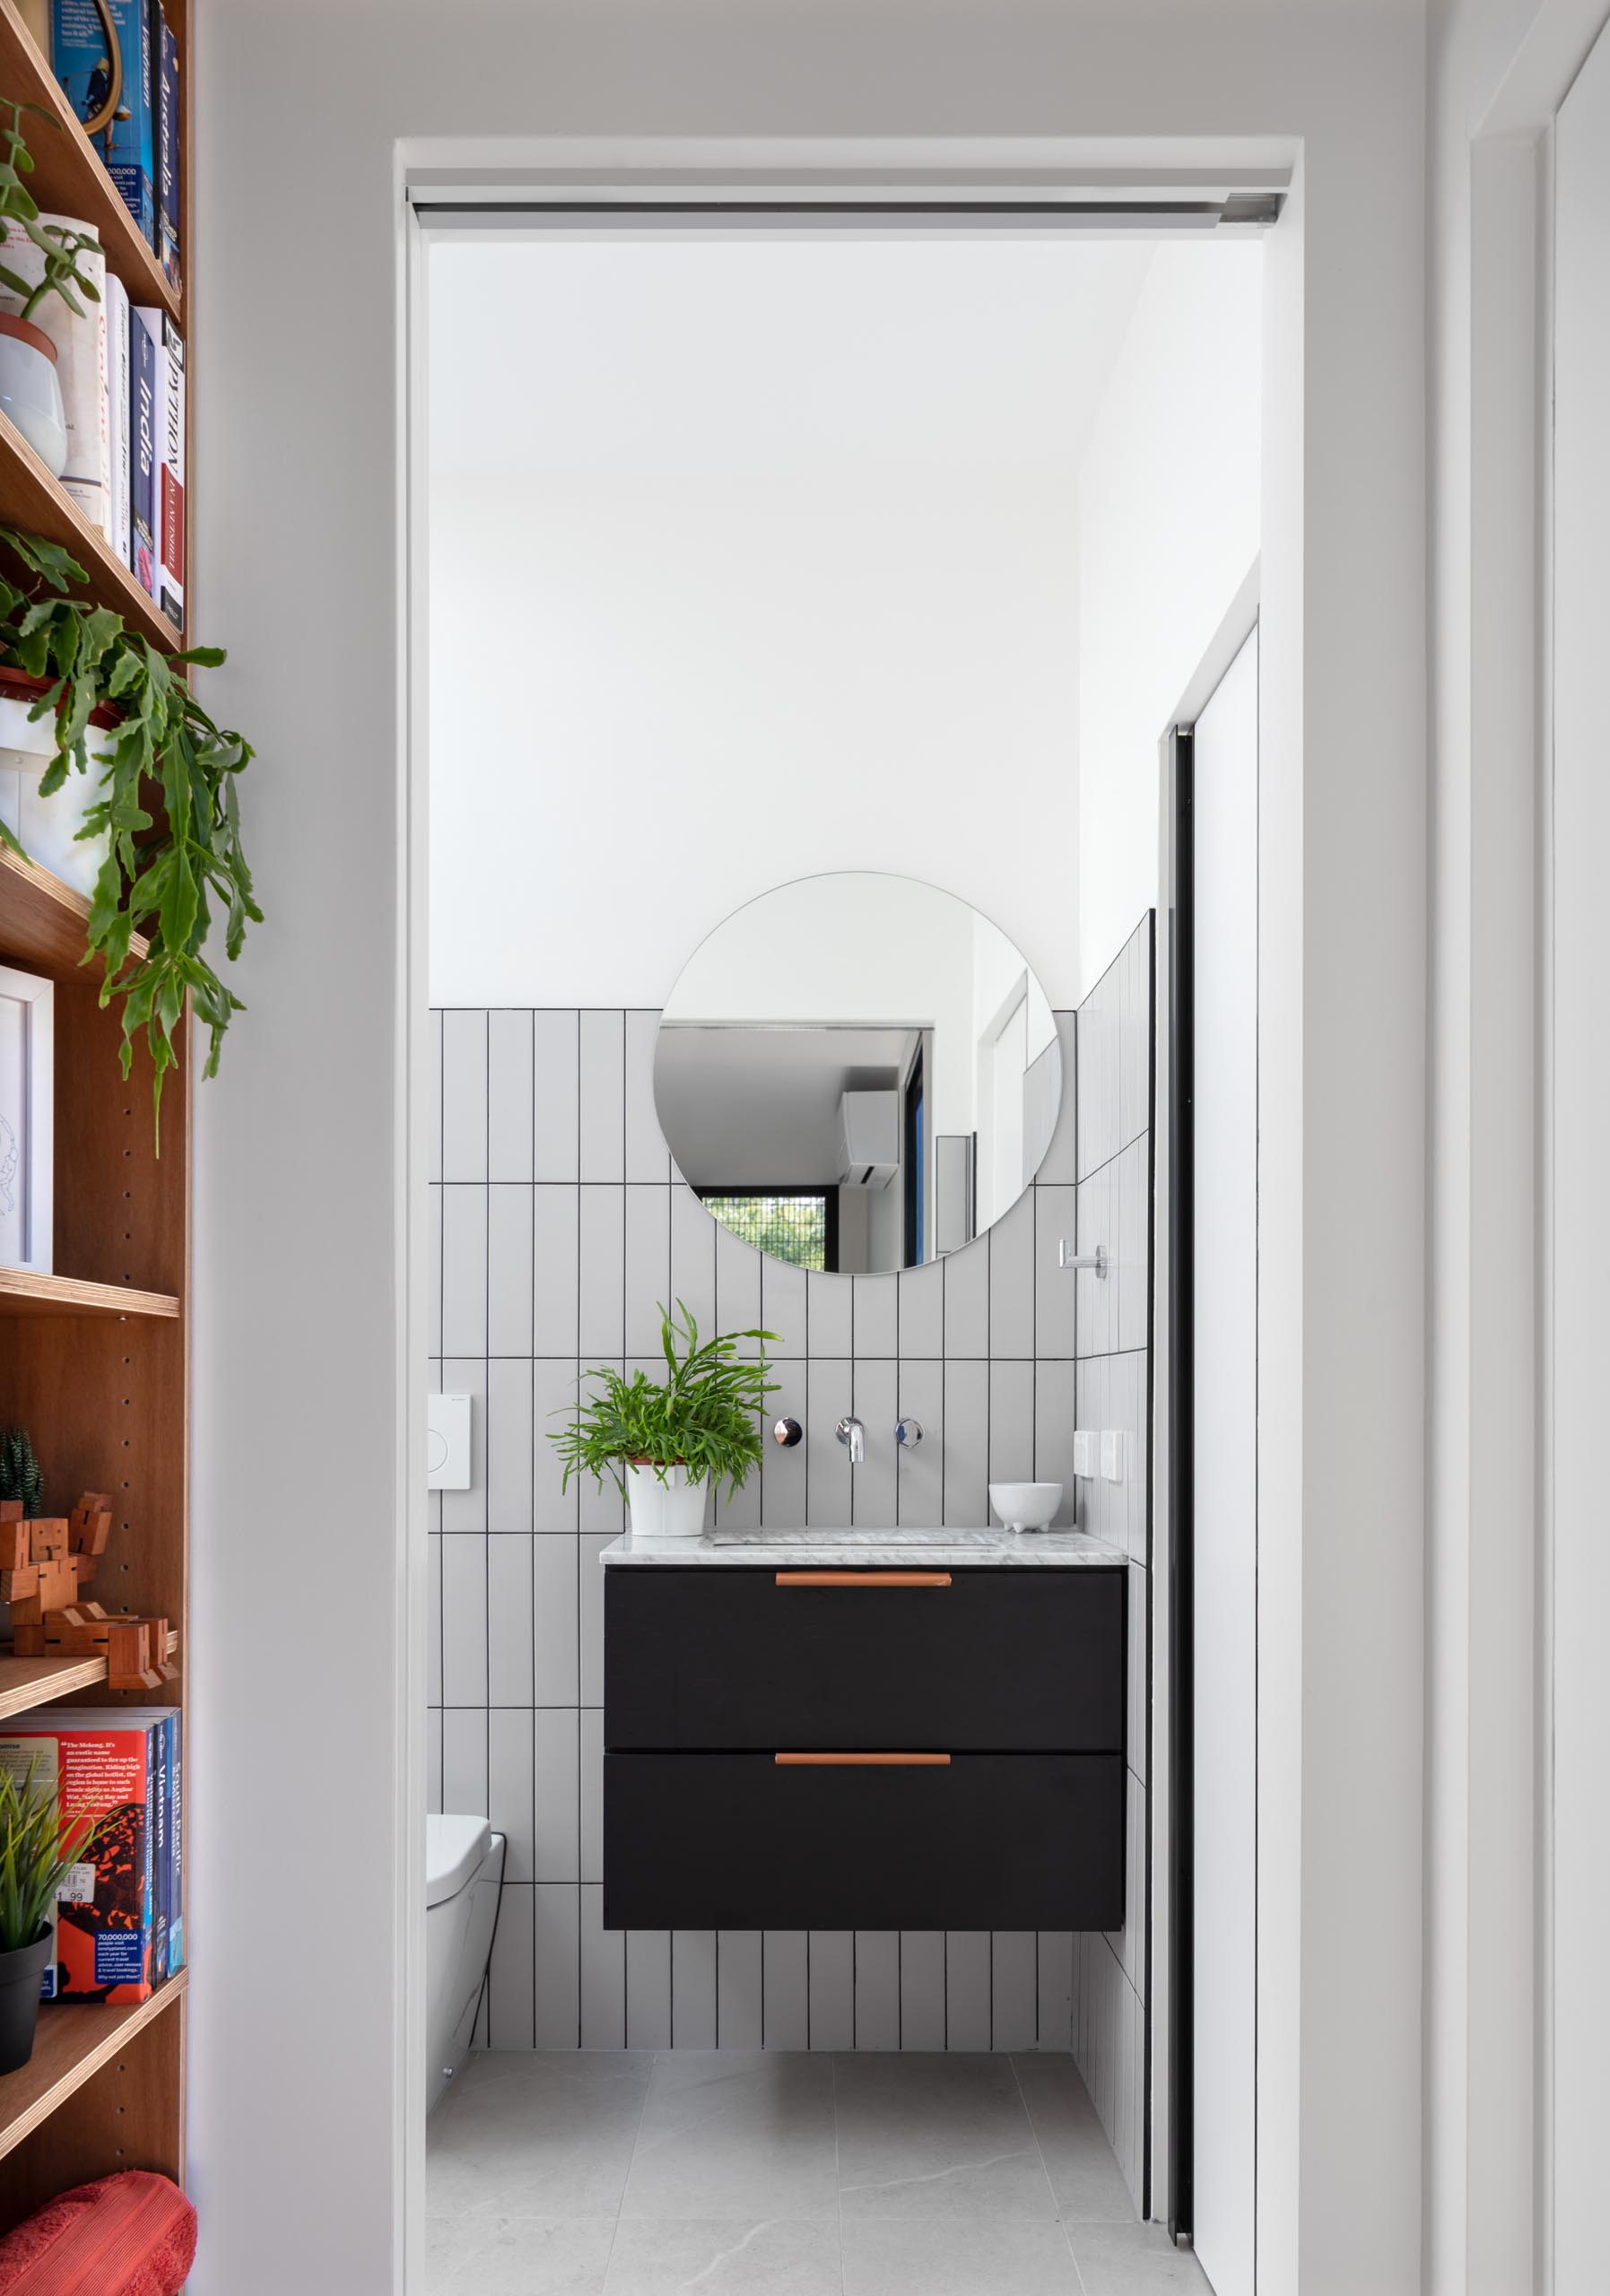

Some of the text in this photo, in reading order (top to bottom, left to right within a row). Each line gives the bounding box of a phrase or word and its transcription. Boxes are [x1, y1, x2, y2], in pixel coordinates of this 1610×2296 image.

[161, 72, 172, 196] Australia
[140, 376, 153, 477] India
[168, 361, 179, 474] PYTHON
